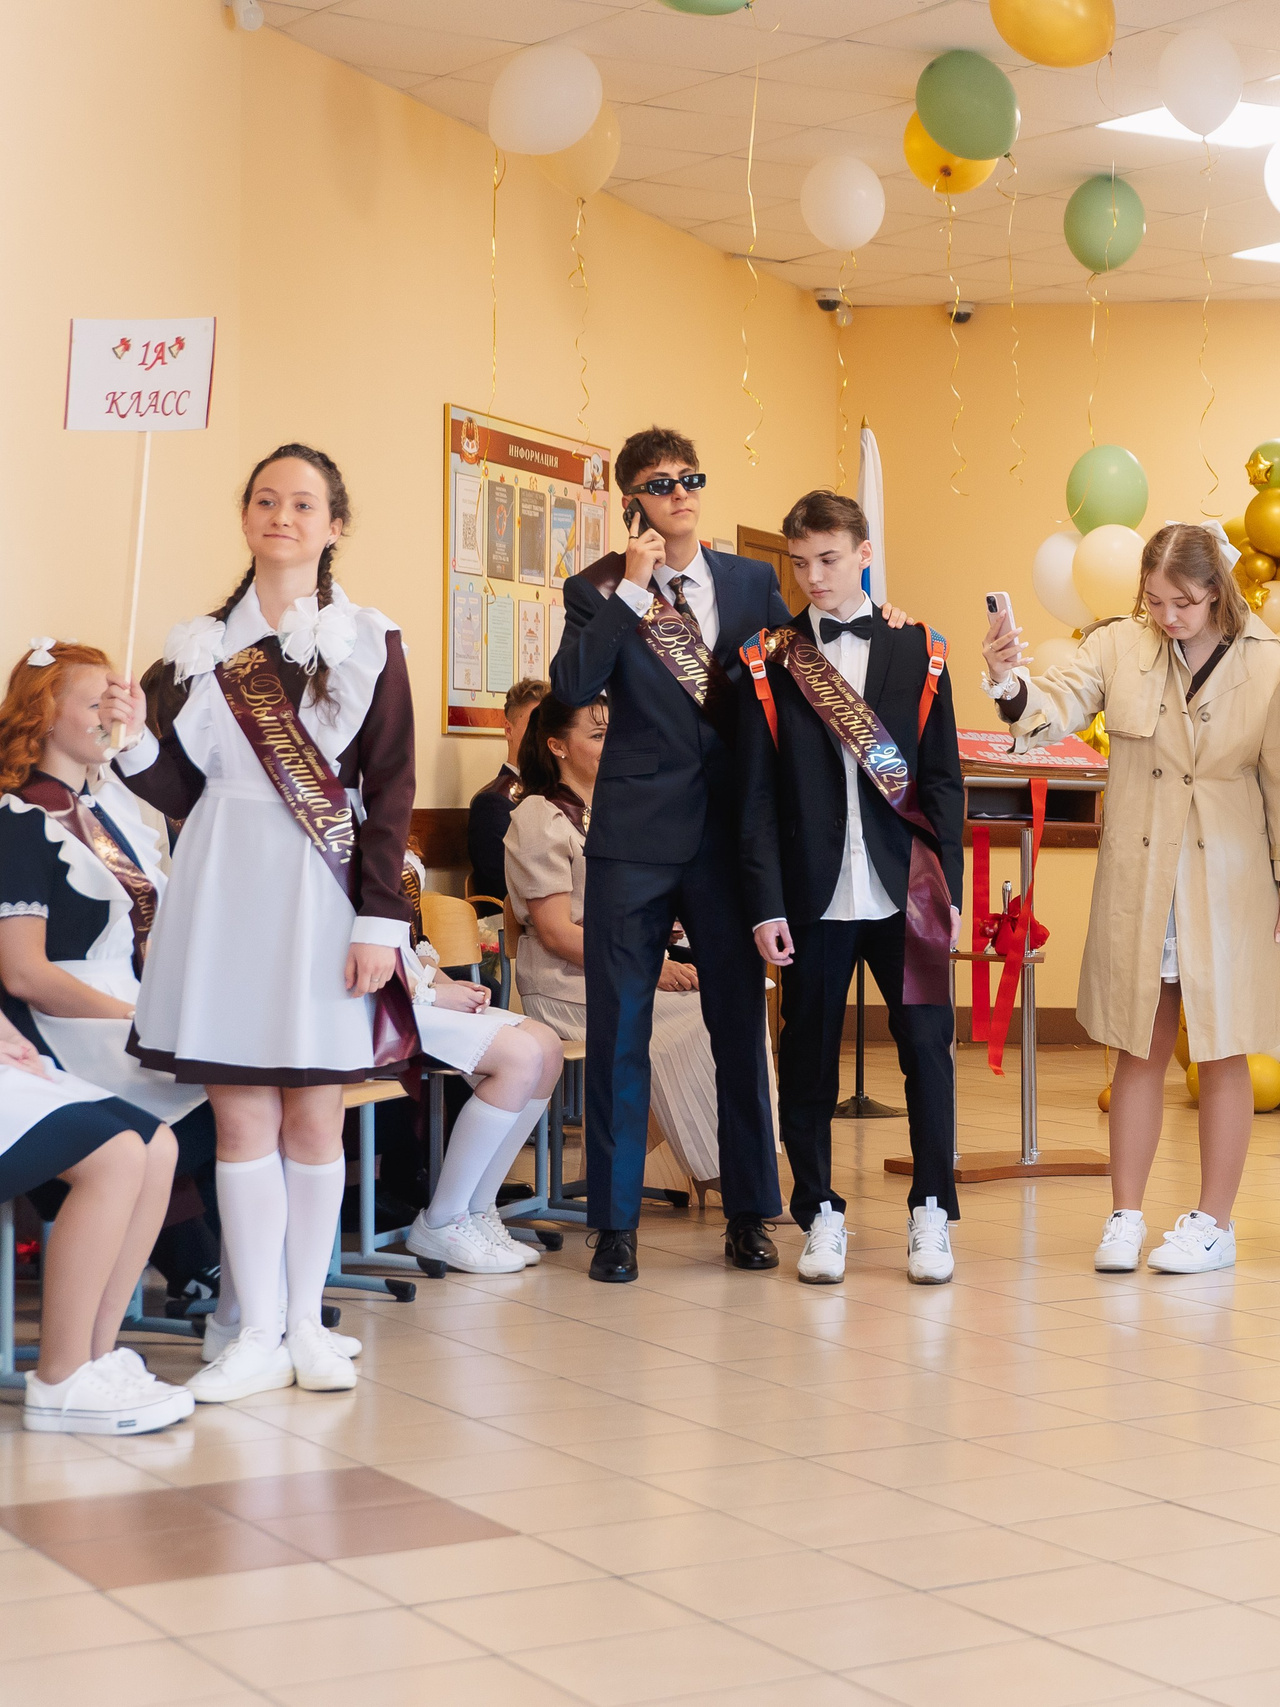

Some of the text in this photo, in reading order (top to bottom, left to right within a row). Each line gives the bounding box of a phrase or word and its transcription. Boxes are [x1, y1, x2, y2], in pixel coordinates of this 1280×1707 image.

[138, 340, 168, 371] 1А
[105, 389, 191, 419] КЛАСС
[508, 443, 559, 469] ИНФОРМАЦИЯ
[789, 643, 881, 754] Выпускник
[867, 746, 912, 793] 2024
[239, 673, 333, 814] Выпускница
